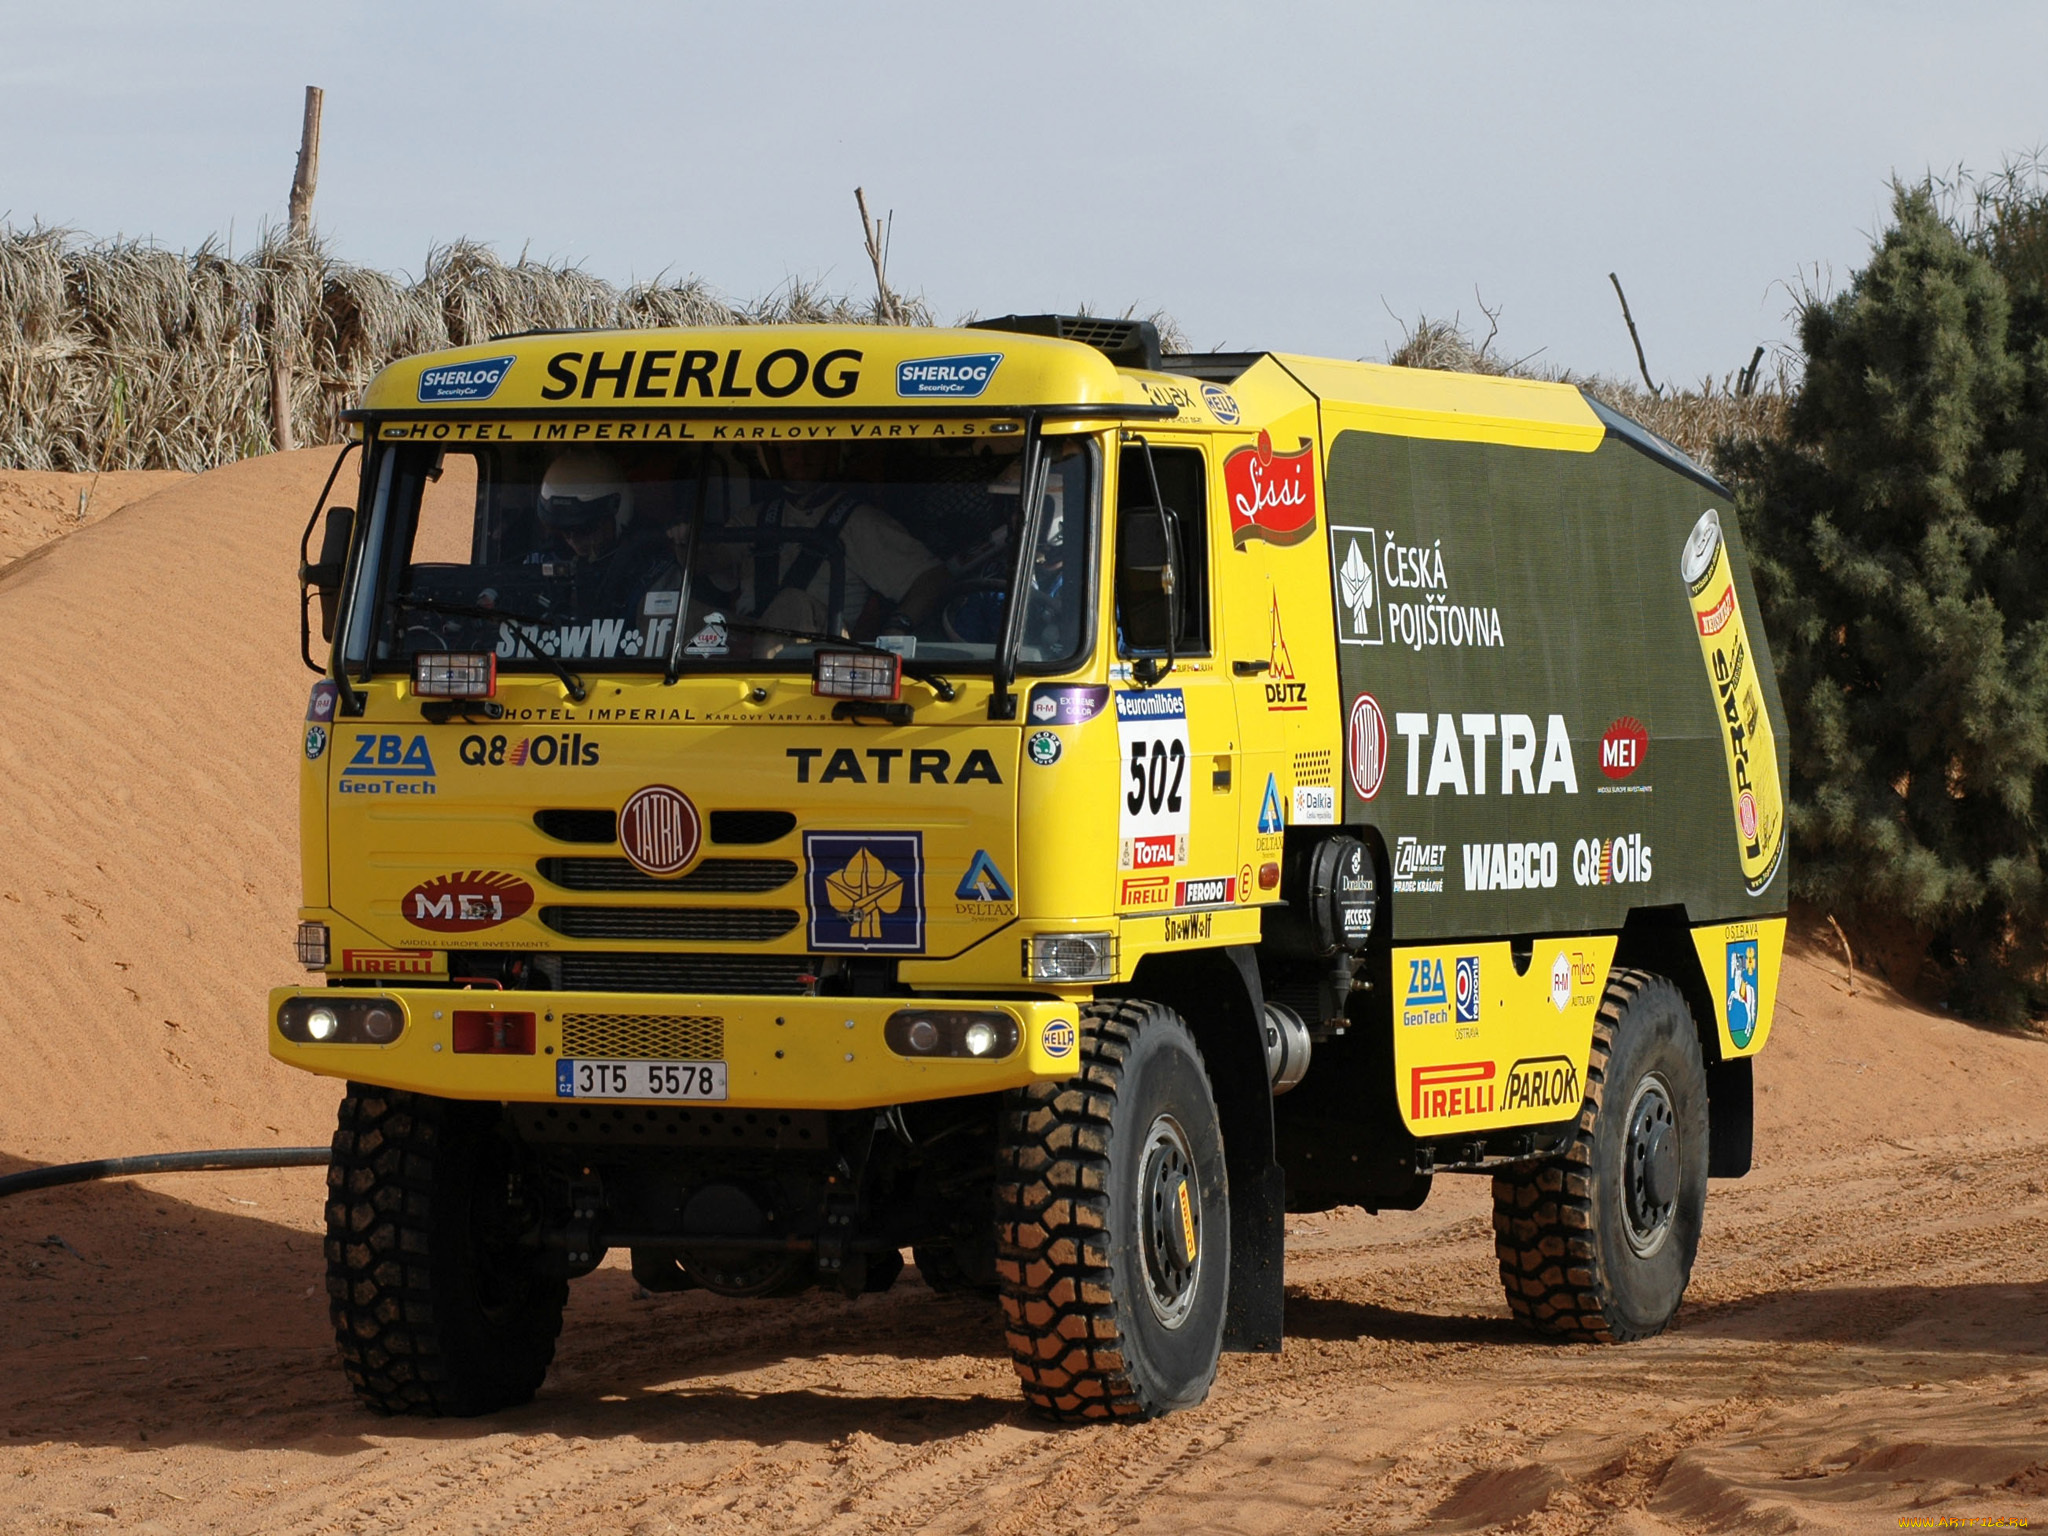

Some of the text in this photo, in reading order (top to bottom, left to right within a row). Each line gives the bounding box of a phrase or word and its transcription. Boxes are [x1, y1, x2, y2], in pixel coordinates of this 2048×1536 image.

[424, 370, 499, 386] SHERLOG
[541, 349, 863, 400] SHERLOG
[902, 366, 987, 381] SHERLOG
[437, 387, 477, 395] SecurityCar
[918, 384, 964, 393] SecurityCar
[1206, 394, 1238, 413] HELLA
[409, 424, 513, 440] HOTEL
[534, 423, 695, 439] IMPERIAL
[713, 426, 837, 439] KARLOVY
[850, 423, 920, 438] VARY
[1236, 457, 1306, 524] Sissi
[1384, 530, 1448, 589] ČESKÁ
[1388, 593, 1505, 652] POJIŠŤOVNA
[505, 709, 575, 720] HOTEL
[589, 709, 696, 720] IMPERIAL
[706, 713, 763, 721] KARLOVY
[769, 713, 801, 721] VARY
[1036, 704, 1054, 713] R-M
[1126, 693, 1184, 716] euromilhões
[348, 735, 436, 771] ZBA
[1353, 703, 1379, 790] TATRA
[1396, 712, 1579, 796] TATRA
[1603, 739, 1636, 767] MEI
[786, 748, 1003, 784] TATRA
[1127, 738, 1186, 816] 502
[339, 780, 436, 794] GeoTech
[1307, 793, 1331, 808] Dalkia
[632, 794, 683, 865] TATRA
[1135, 842, 1174, 864] TOTAL
[1256, 836, 1284, 851] DELTAX
[1463, 842, 1558, 891] WABCO
[1121, 876, 1170, 905] PIRELLI
[1187, 879, 1224, 902] FERODO
[1343, 875, 1373, 891] Donaldson
[415, 893, 502, 920] MEI
[956, 904, 1014, 916] DELTAX
[1725, 924, 1758, 940] OSTRAVA
[342, 949, 433, 973] PIRELLI
[1407, 958, 1447, 1003] ZBA
[1553, 973, 1568, 991] R-M
[1404, 1010, 1447, 1026] GeoTech
[1044, 1030, 1074, 1046] HELLA
[1455, 1027, 1479, 1040] OSTRAVA
[559, 1064, 713, 1095] CZ 3T5 5578
[1411, 1061, 1496, 1120] PIRELLI
[1508, 1068, 1577, 1110] PARLOK
